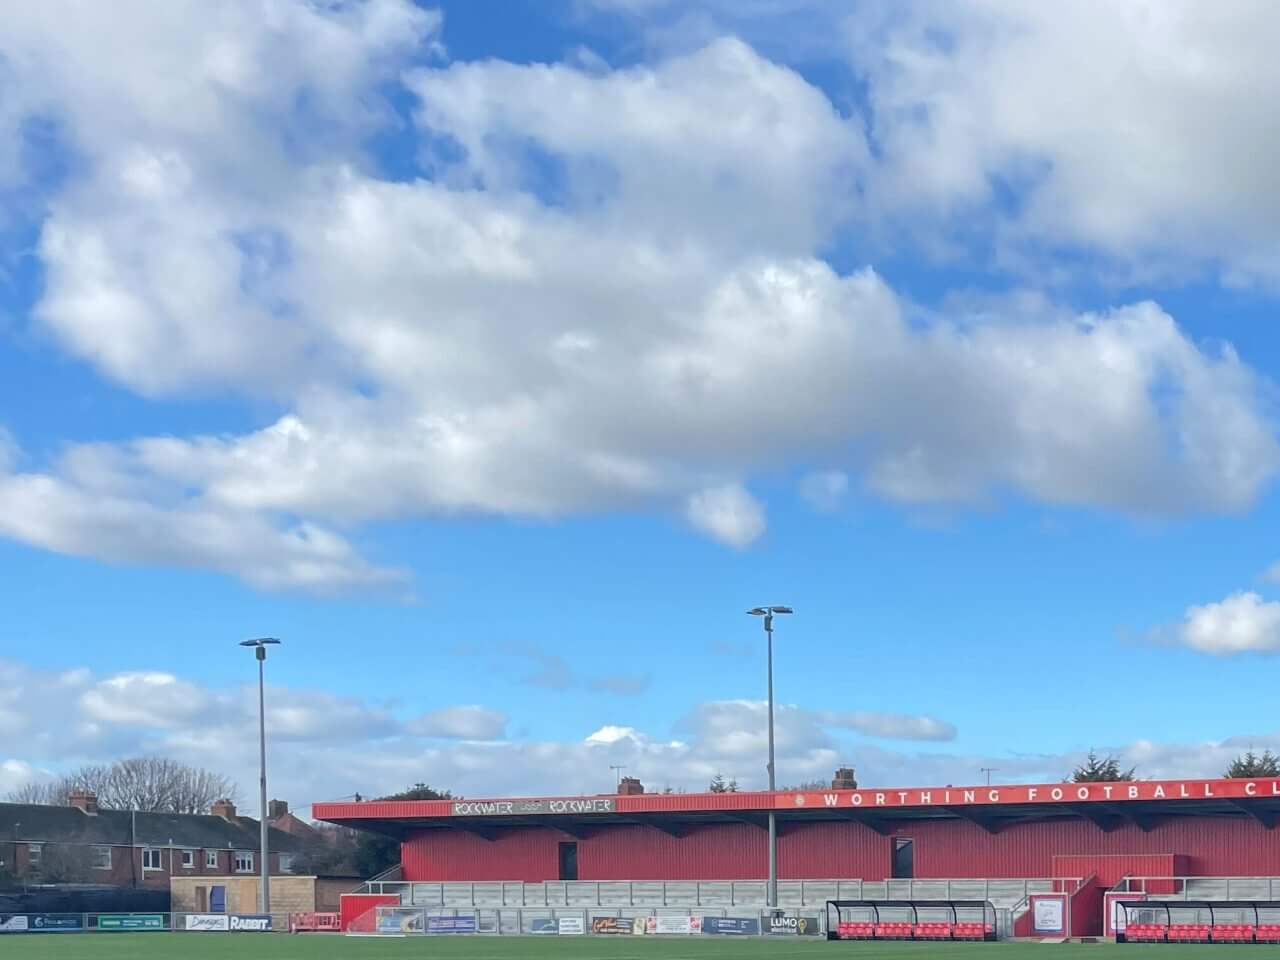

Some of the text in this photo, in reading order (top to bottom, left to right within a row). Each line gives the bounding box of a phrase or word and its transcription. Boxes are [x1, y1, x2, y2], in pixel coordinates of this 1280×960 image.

[824, 788, 1000, 806] WORTHING
[1028, 781, 1214, 801] FOOTBALL
[455, 801, 513, 815] ROCKWATER
[550, 799, 611, 813] ROCKWATER
[771, 917, 798, 928] LUMO
